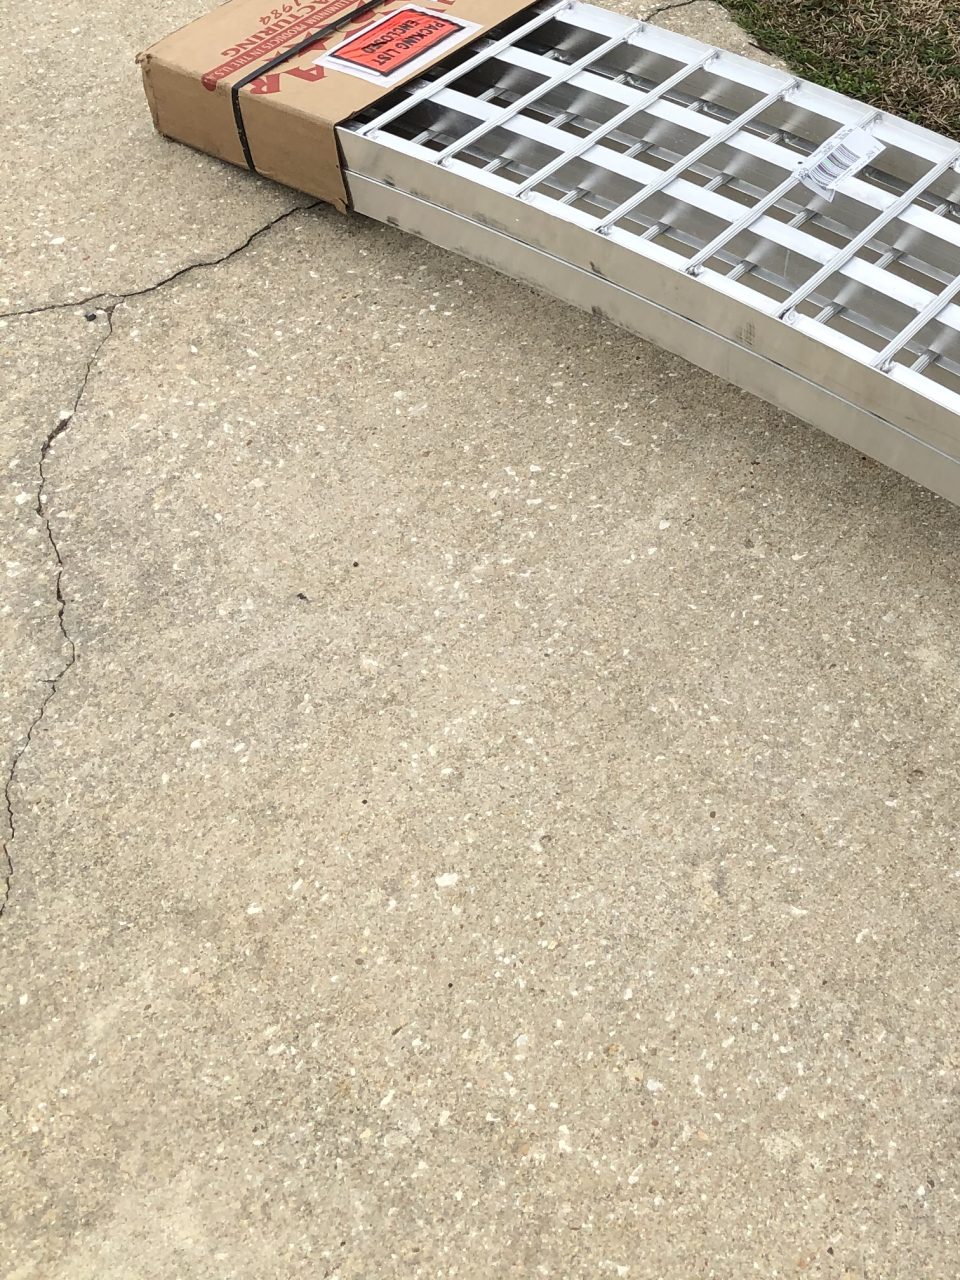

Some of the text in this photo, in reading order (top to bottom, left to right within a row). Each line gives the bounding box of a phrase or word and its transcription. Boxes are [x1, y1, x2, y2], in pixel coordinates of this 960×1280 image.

[257, 0, 304, 23] 1984
[259, 23, 309, 50] PRODUCTS
[358, 19, 421, 54] ENCLOSED
[392, 20, 447, 50] PACKING
[229, 55, 253, 67] THE
[248, 48, 265, 56] IN
[367, 47, 403, 65] LIST
